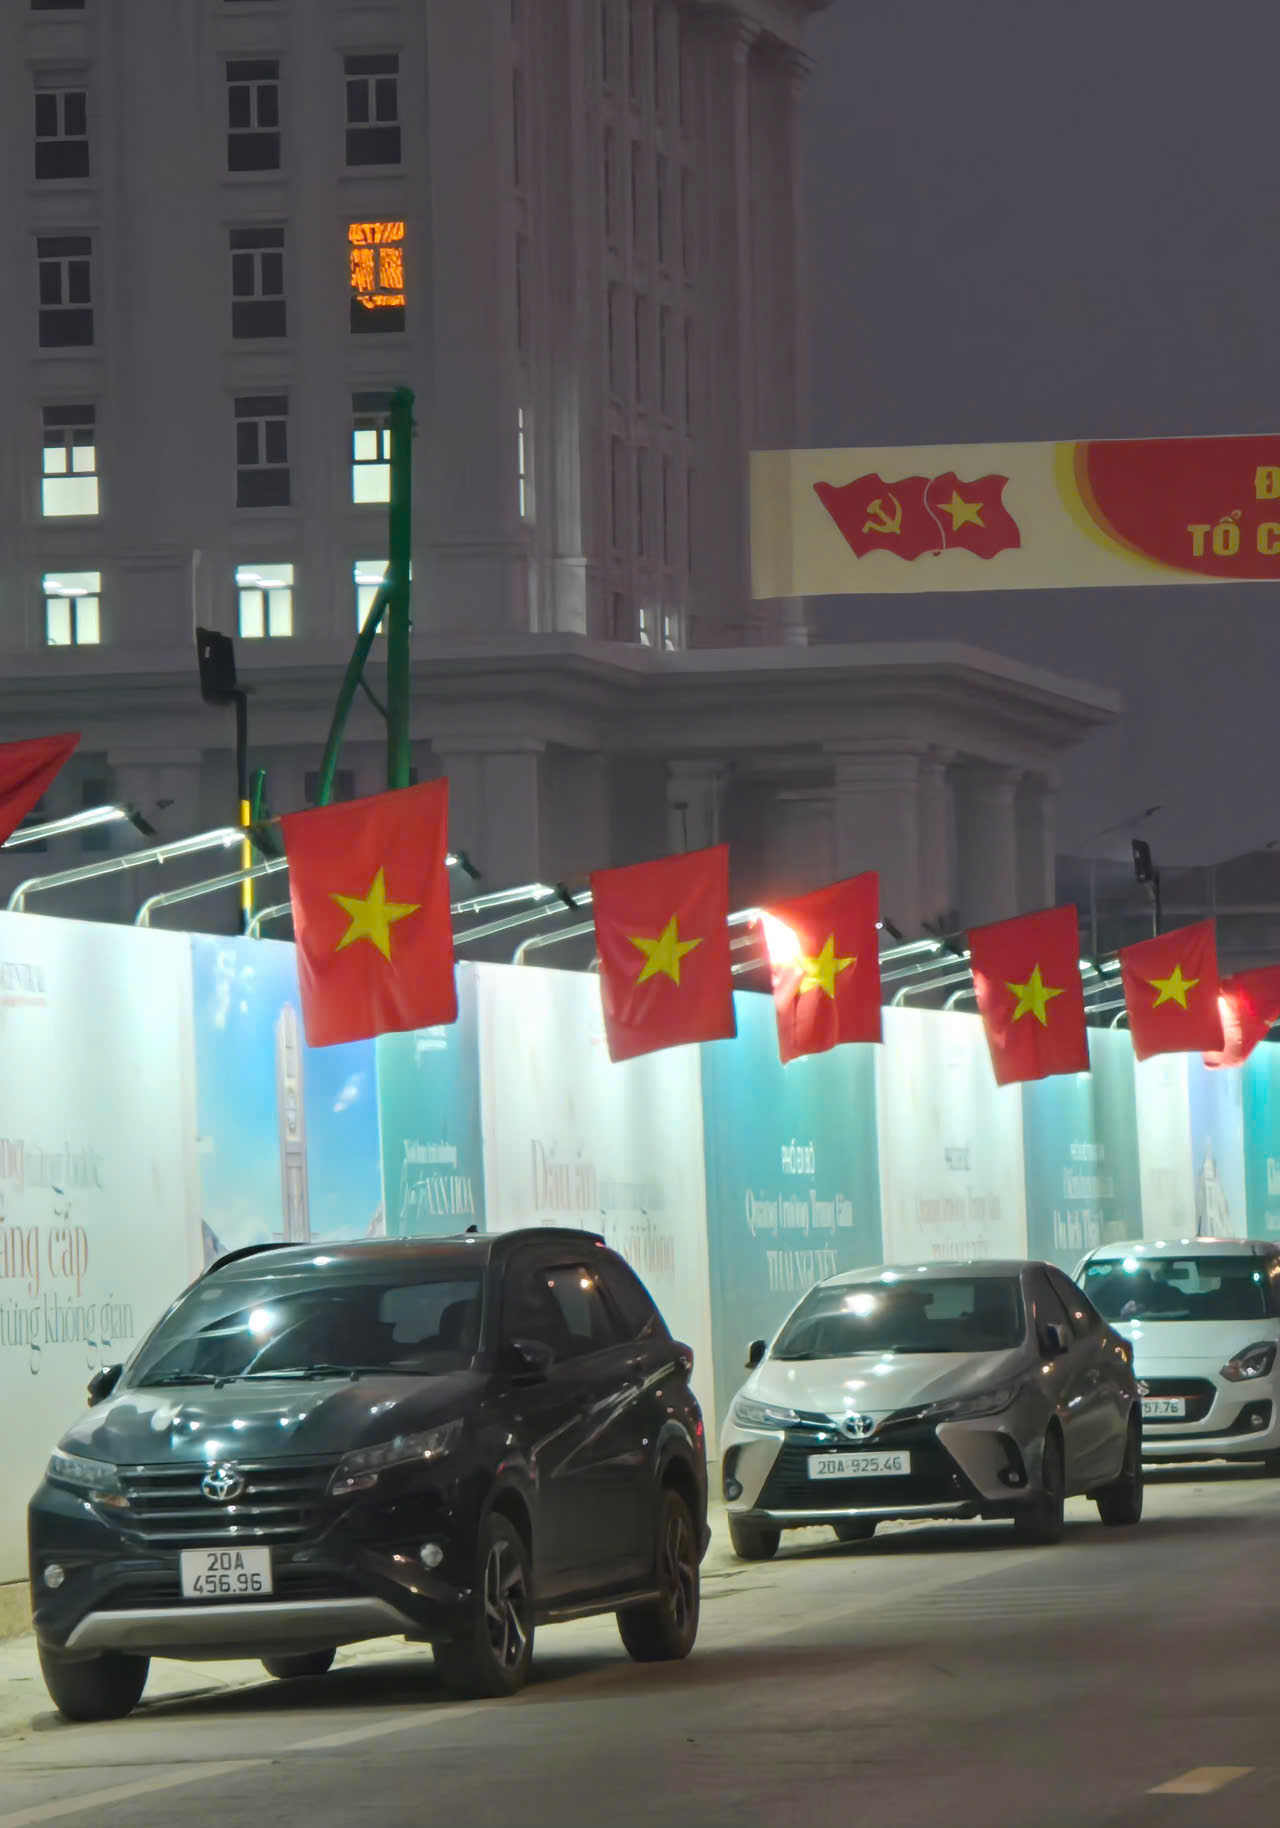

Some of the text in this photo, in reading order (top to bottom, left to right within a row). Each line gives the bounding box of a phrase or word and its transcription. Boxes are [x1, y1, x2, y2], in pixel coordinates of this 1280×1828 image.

[1187, 508, 1241, 557] TỔ
[207, 1552, 244, 1571] 20A
[192, 1573, 262, 1594] 456.96
